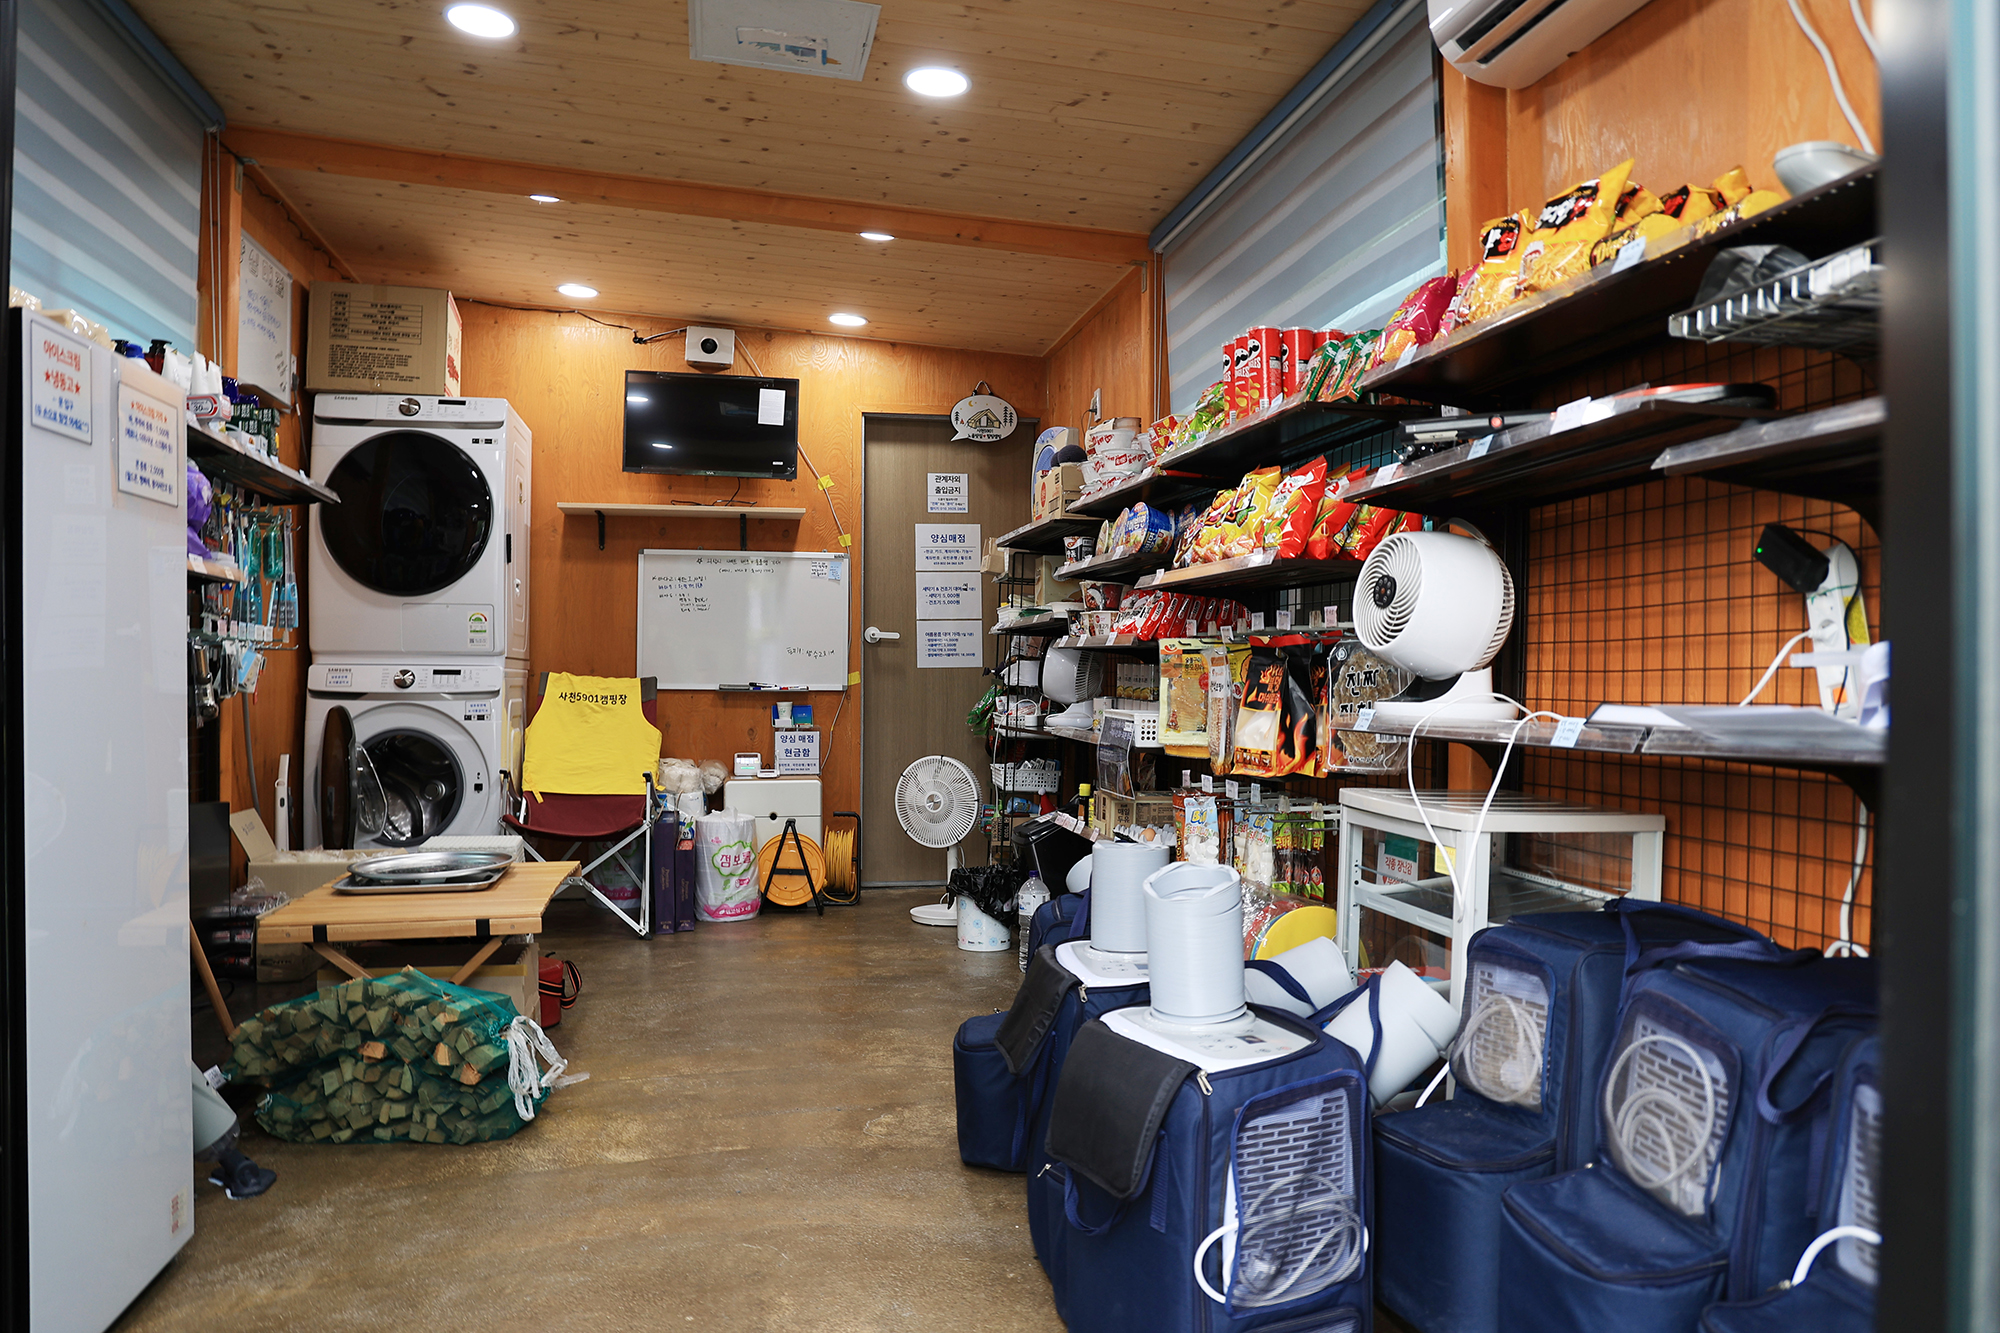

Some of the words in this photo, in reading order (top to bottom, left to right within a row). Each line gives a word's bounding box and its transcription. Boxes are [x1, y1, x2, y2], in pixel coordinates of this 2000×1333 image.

[43, 339, 81, 372] 아이스크림
[51, 369, 74, 393] 냉동고
[934, 475, 961, 484] 관계자외
[934, 486, 961, 495] 출입금지
[930, 534, 966, 543] 양심매점
[558, 691, 628, 706] 사천5901캠핑장
[780, 734, 796, 744] 양심
[798, 734, 814, 744] 매점
[784, 748, 811, 757] 현금함
[1117, 808, 1131, 816] 매일
[1385, 856, 1397, 871] 각종
[1397, 859, 1413, 876] 장난감
